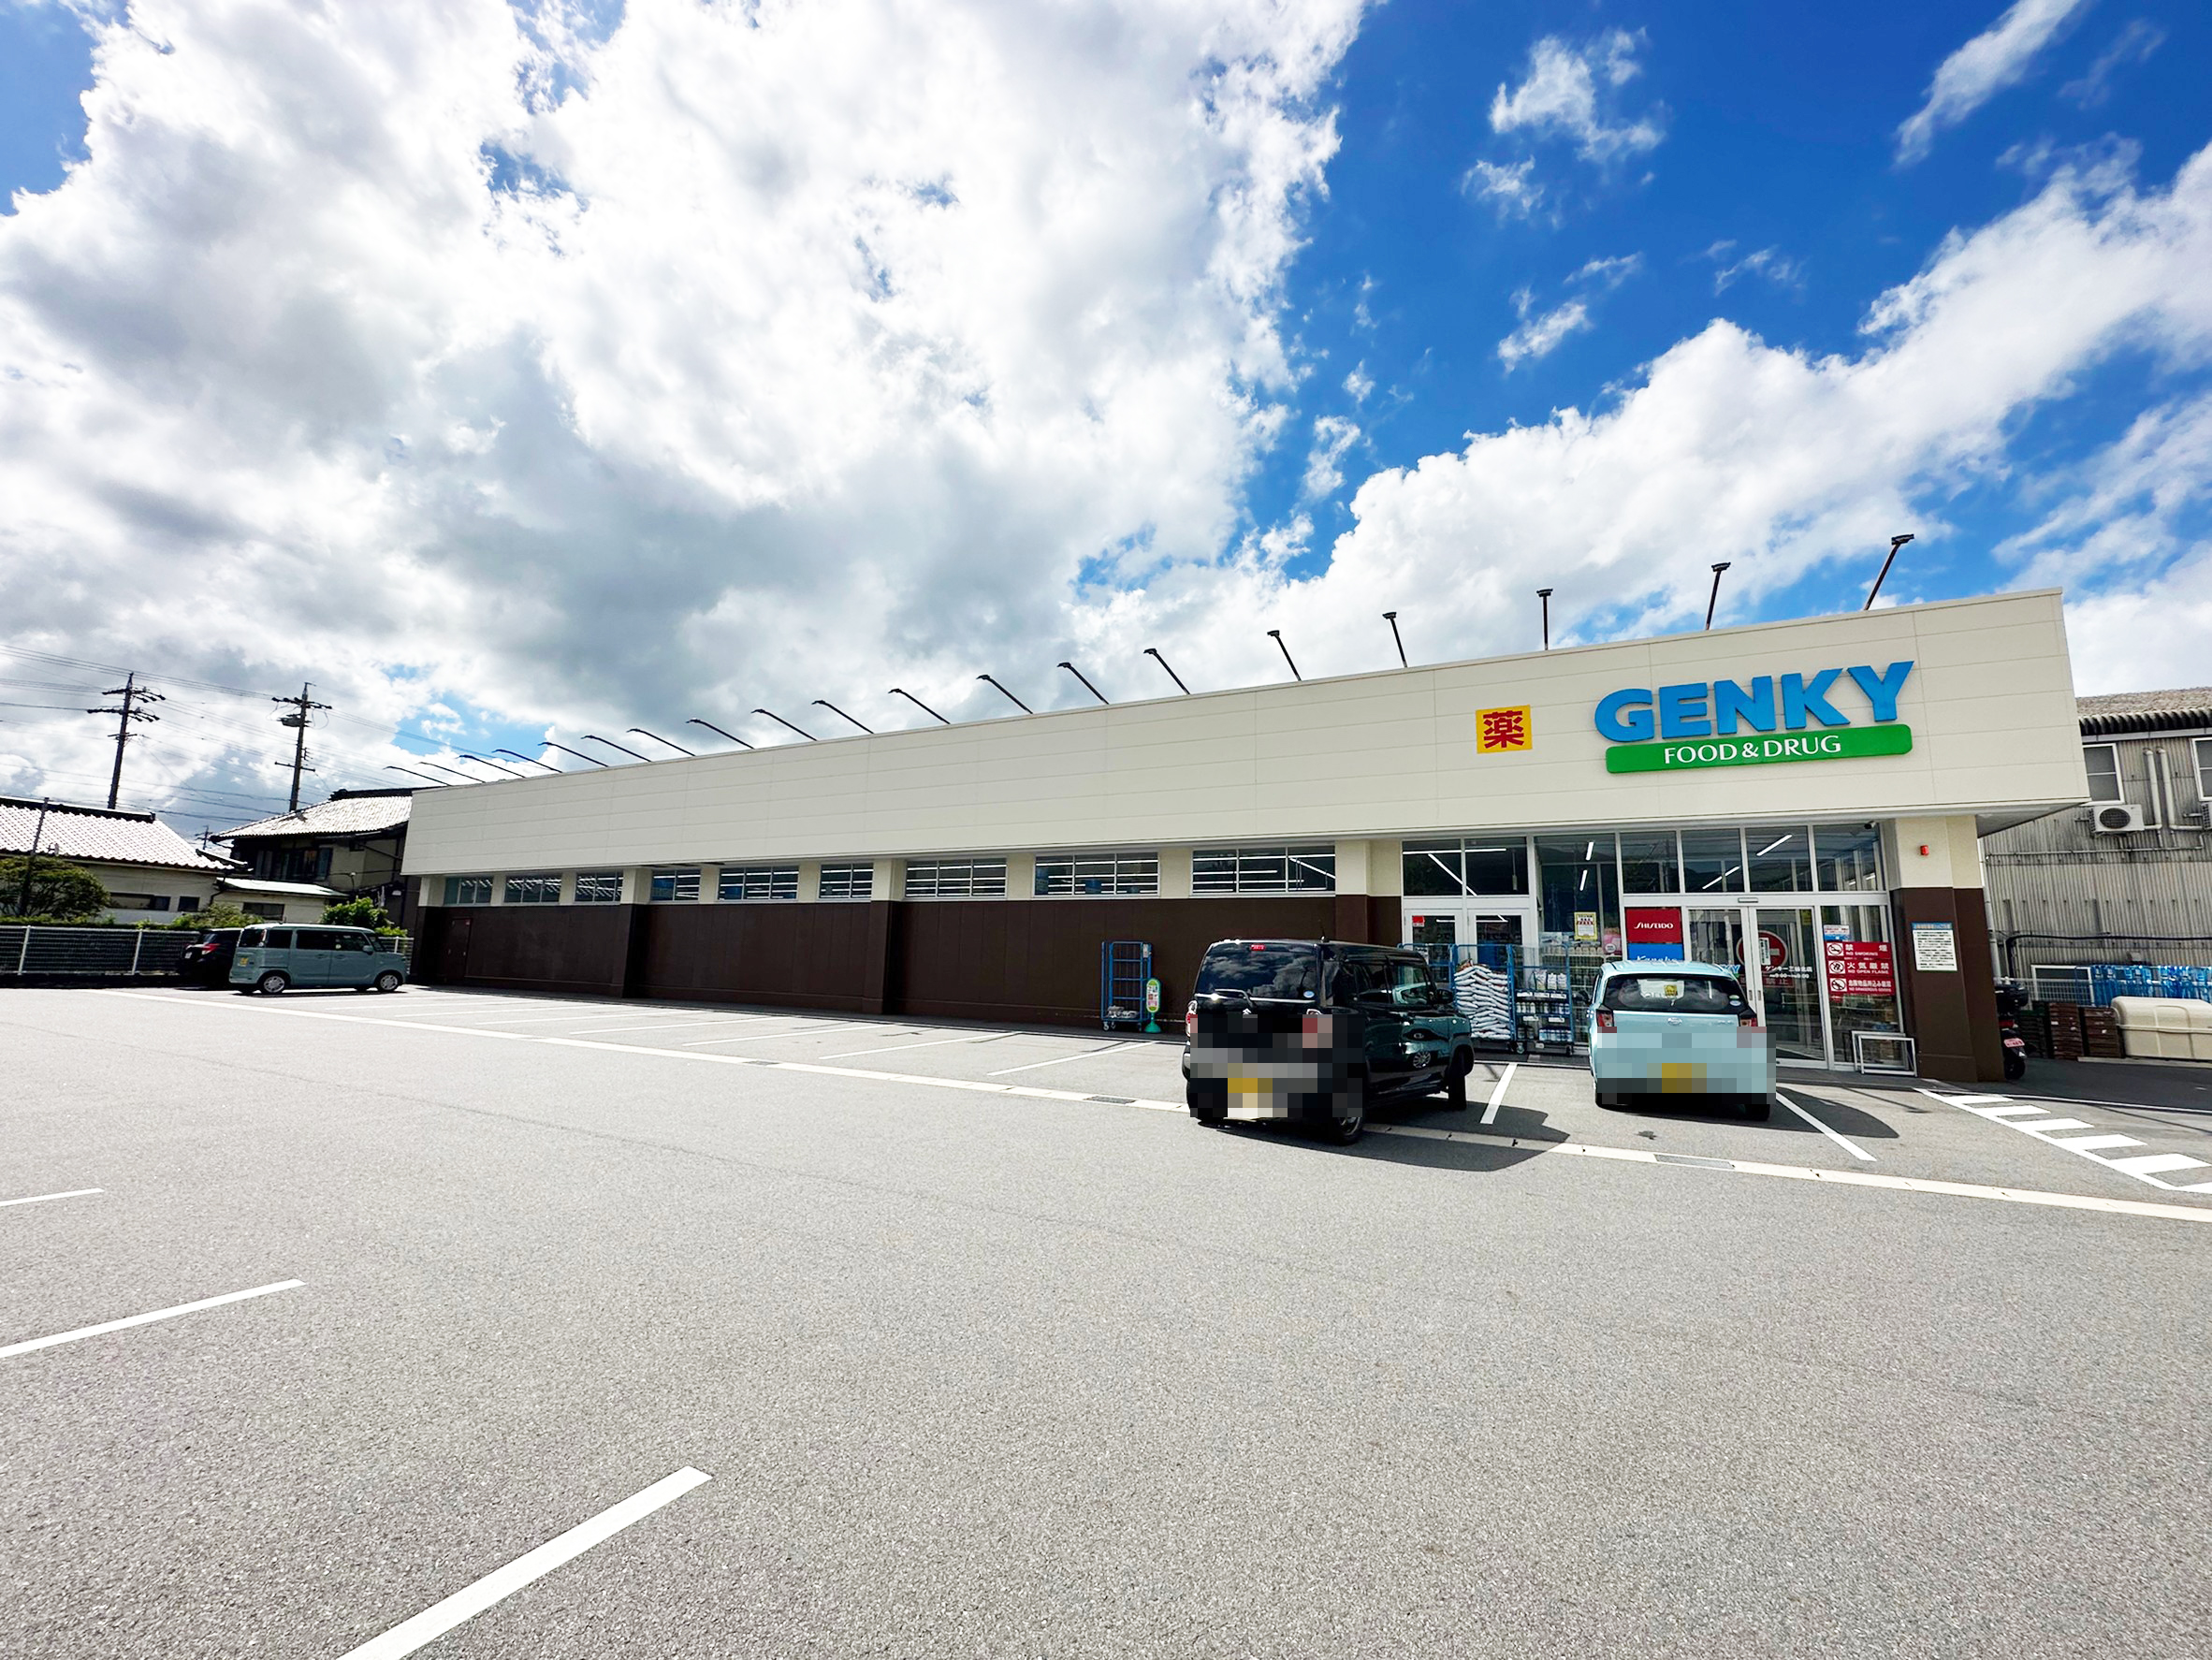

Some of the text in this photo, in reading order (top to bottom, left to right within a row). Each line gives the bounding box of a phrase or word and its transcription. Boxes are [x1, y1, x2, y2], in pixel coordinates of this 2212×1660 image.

[1594, 660, 1914, 743] GENKY
[1482, 709, 1525, 750] 薬
[1664, 735, 1841, 764] FOOD & DRUG
